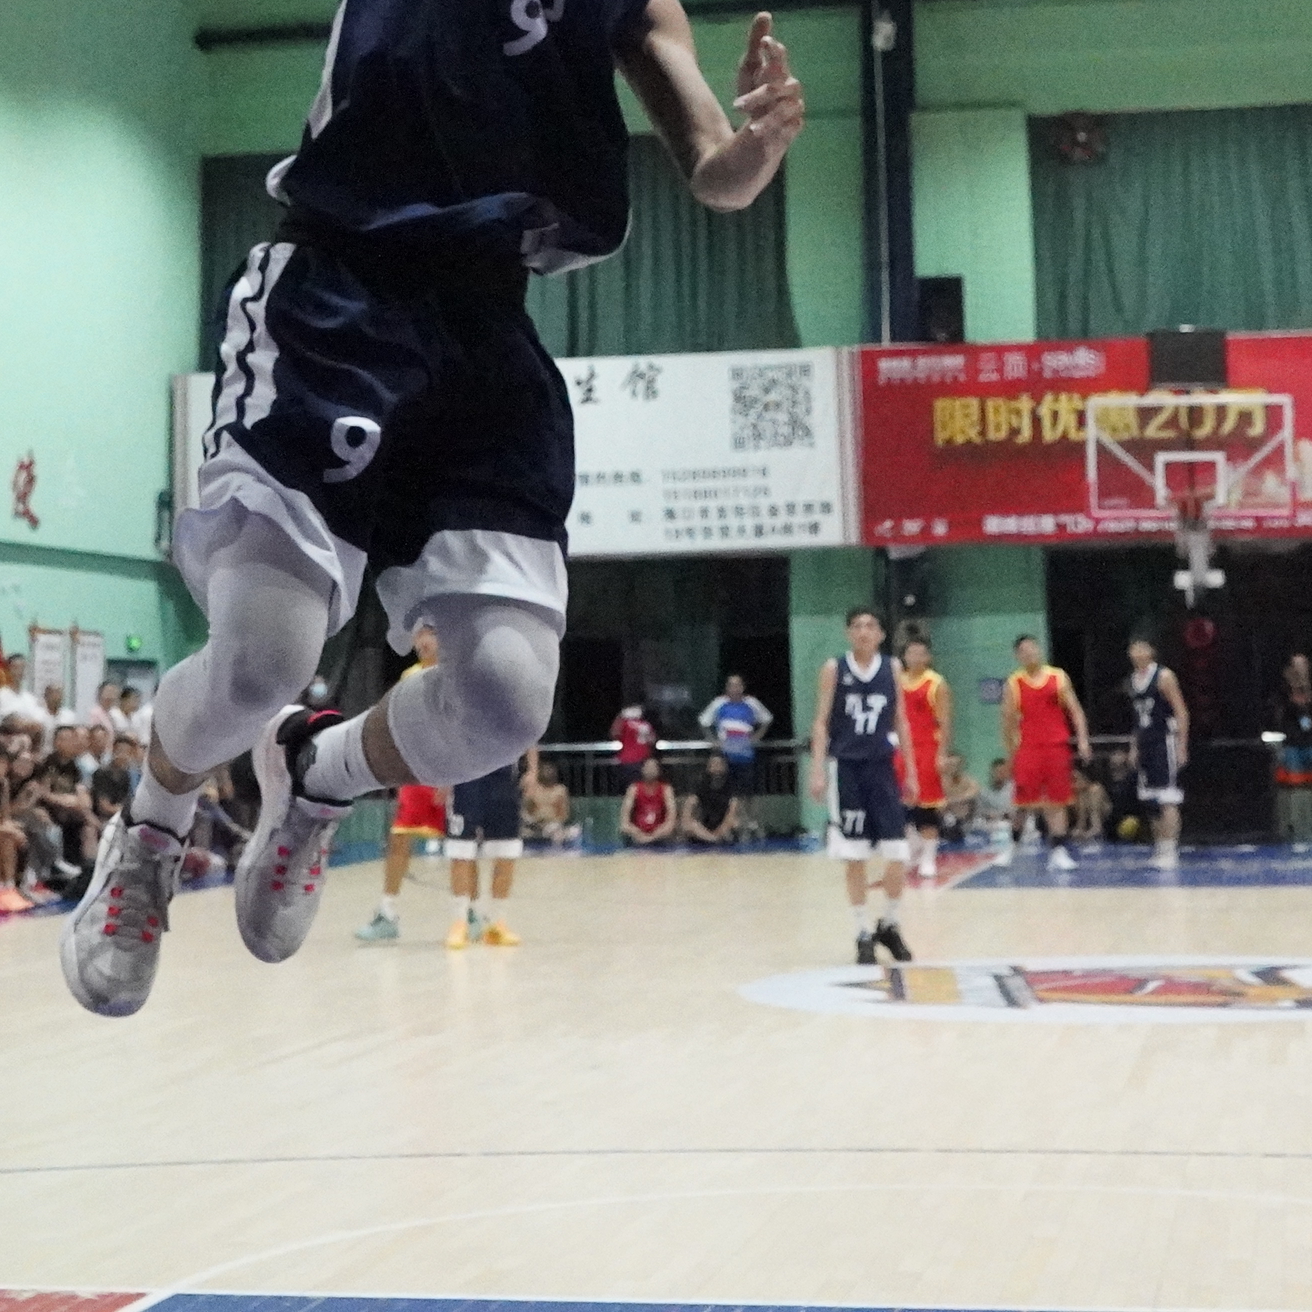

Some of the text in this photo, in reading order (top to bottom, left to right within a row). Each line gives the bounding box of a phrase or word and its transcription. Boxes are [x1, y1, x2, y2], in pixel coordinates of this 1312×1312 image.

[323, 415, 381, 483] 9
[932, 389, 1270, 448] 限时优惠20万
